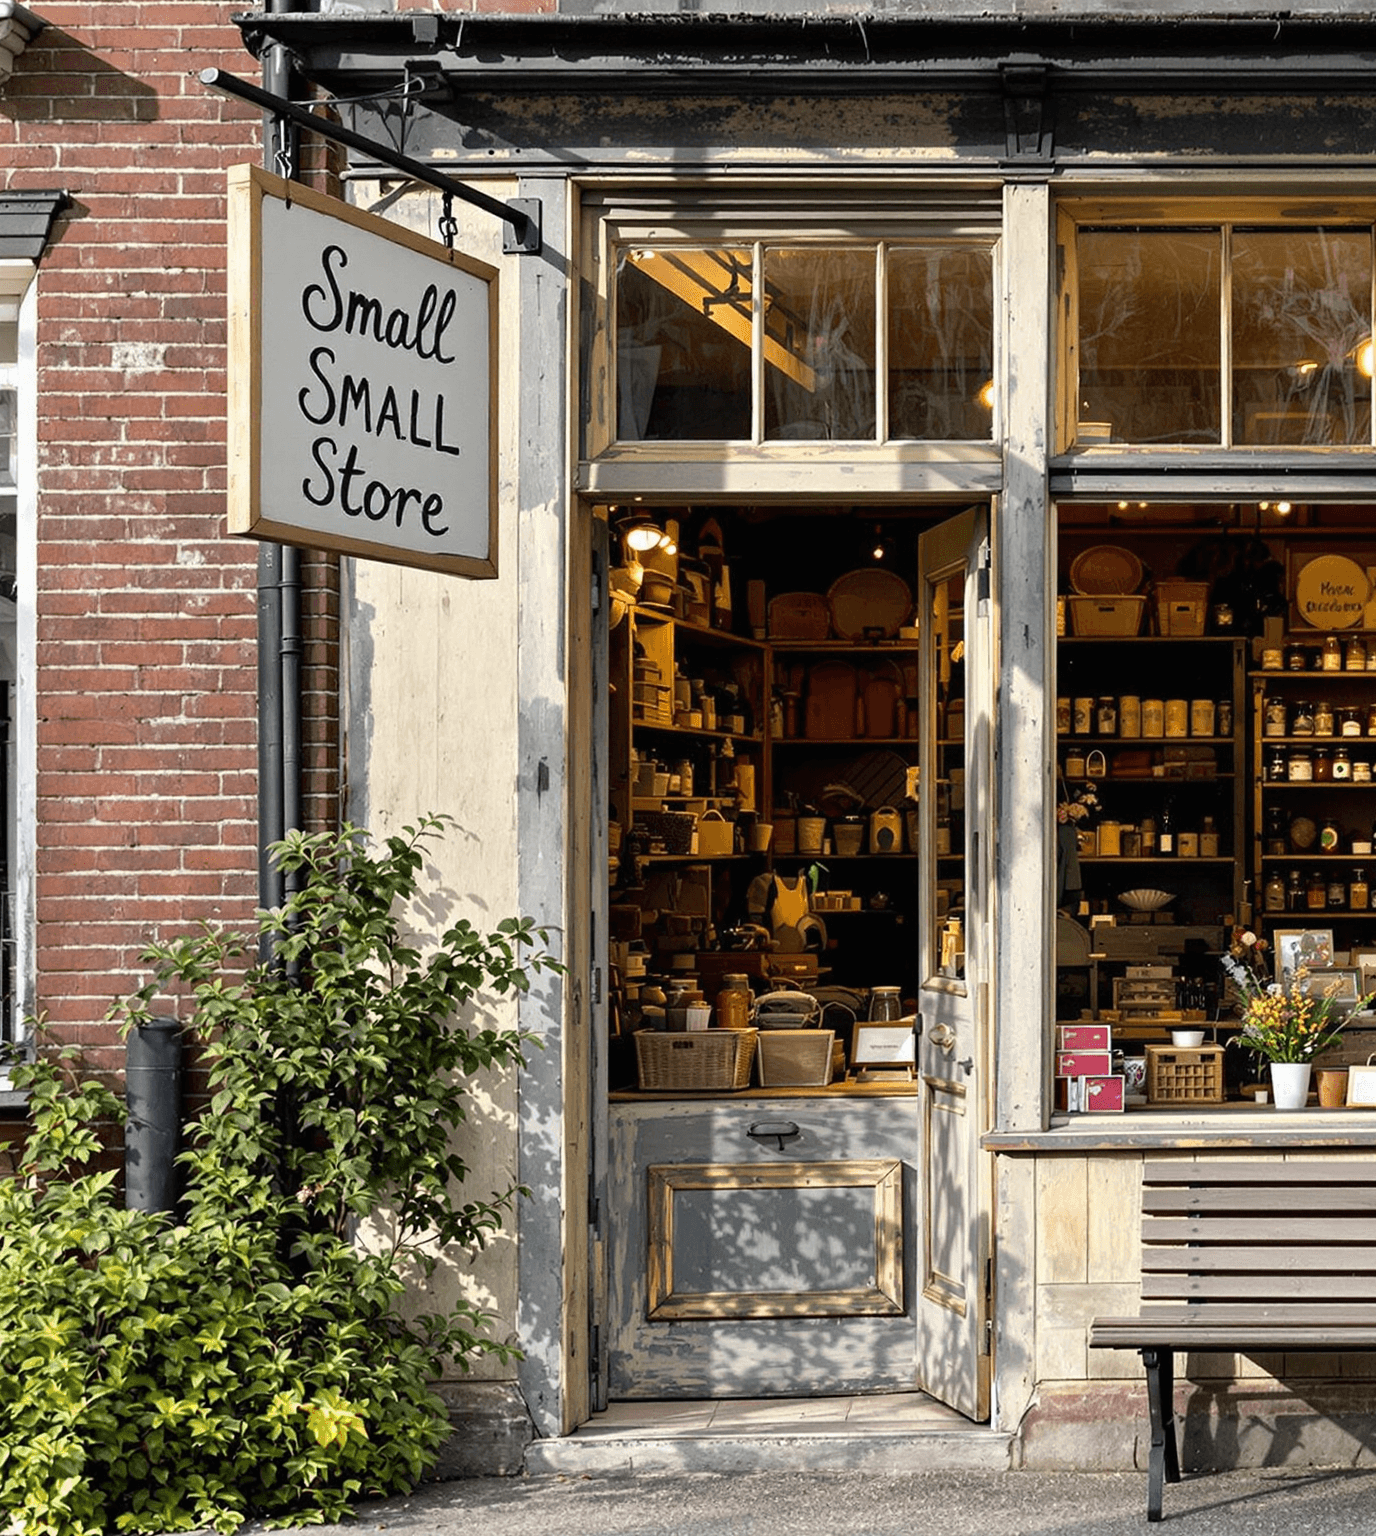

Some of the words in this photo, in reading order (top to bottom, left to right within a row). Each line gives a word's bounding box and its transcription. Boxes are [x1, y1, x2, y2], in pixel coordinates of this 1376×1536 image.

[302, 244, 456, 364] Small
[299, 347, 460, 455] SMALL
[302, 436, 449, 536] Store
